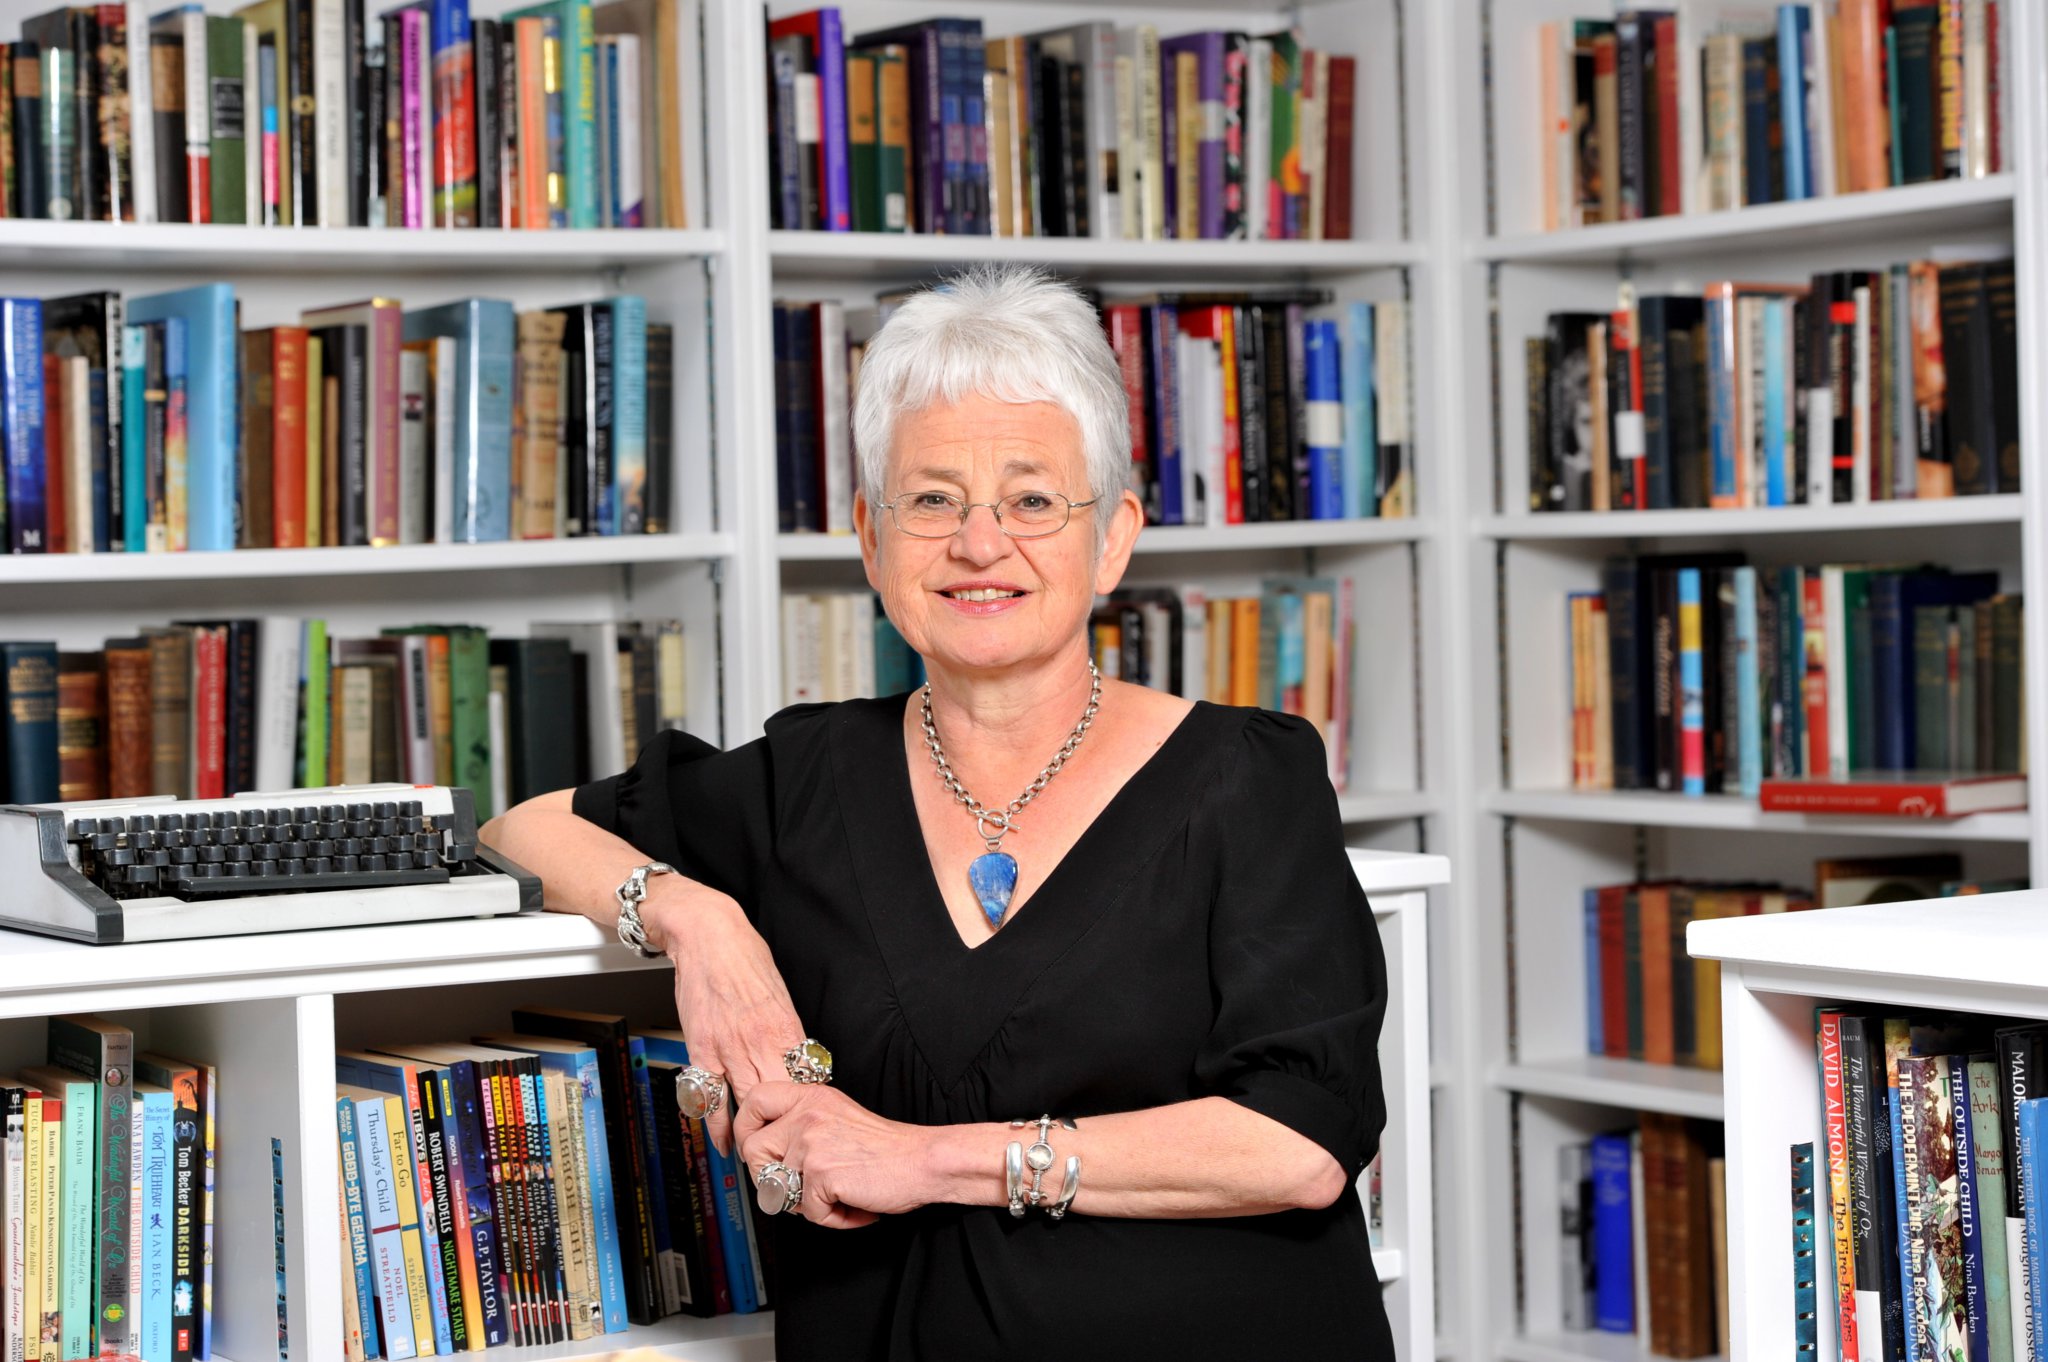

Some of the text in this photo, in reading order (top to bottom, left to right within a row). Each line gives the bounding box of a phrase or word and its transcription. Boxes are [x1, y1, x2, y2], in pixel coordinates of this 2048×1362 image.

[108, 1094, 128, 1120] The
[1972, 1092, 2000, 1117] Ark
[1974, 1072, 1990, 1089] The
[31, 1104, 39, 1133] TUCK
[48, 1130, 56, 1157] BARRIE
[76, 1106, 85, 1137] FRANK
[344, 1105, 352, 1136] ARMADA
[414, 1123, 427, 1160] BOYS
[528, 1079, 536, 1121] TELLING
[533, 1127, 541, 1157] TALES
[539, 1184, 547, 1206] ANNE
[589, 1110, 597, 1125] THE
[30, 1139, 38, 1215] EVERLASTING
[76, 1140, 84, 1165] BAUM
[104, 1125, 128, 1183] Wonderful
[146, 1126, 167, 1210] TOM TRUEHEART
[367, 1109, 391, 1213] Thursday's Child
[393, 1130, 410, 1188] Far to Go
[429, 1131, 444, 1172] ROBERT
[493, 1080, 518, 1242] TELLING TALES JENNY NIMMO
[504, 1081, 532, 1271] TELLING TALES MICHAEL MORPURGO
[514, 1082, 540, 1260] TELLING TALES THERESA BRESLIN
[521, 1078, 546, 1246] TELLING TALES GILLIAN CROSS
[538, 1079, 564, 1271] TELLING TALES MICHELLE MAGORIAN
[591, 1127, 602, 1176] ADVENTURES
[1844, 1083, 1852, 1124] KANSAS
[1848, 1130, 1856, 1201] CENTENNIAL
[1852, 1207, 1860, 1256] EDITION
[1850, 1057, 1872, 1239] The Wonderful Wizard of Oz
[48, 1165, 56, 1190] PETER
[48, 1191, 56, 1206] PAN
[130, 1112, 142, 1294] NINA BAWDEN THE OUTSIDE CHILD
[342, 1141, 368, 1266] GOOD-BYE GEMMA
[420, 1168, 432, 1198] Club
[433, 1176, 452, 1234] SWINDELLS
[449, 1135, 466, 1229] ROOM 13 Robert Swindells
[483, 1082, 512, 1274] TELLING TALES JACQUELINE WILSON
[558, 1123, 582, 1272] THE HOBBIT
[597, 1179, 603, 1188] OF
[697, 1156, 714, 1217] SKYMAZE
[1822, 1023, 1853, 1342] DAVID ALMOND The Fire-Eaters
[1952, 1068, 1979, 1333] THE OUTSIDE CHILD Nina Bawden
[48, 1207, 55, 1216] IN
[108, 1186, 126, 1231] Wizard
[177, 1146, 192, 1276] Tom Becker DARKSIDE
[601, 1211, 609, 1242] SAWYER
[1891, 1092, 1920, 1362] SECRET HEART DAVID ALMOND
[1898, 1070, 1929, 1344] THE PEPPERMINT PIG Nina Bawden
[29, 1251, 37, 1276] Babbitt
[47, 1217, 55, 1266] KENSINGTON
[103, 1233, 122, 1245] of
[105, 1247, 125, 1269] Oz
[152, 1233, 162, 1259] IAN
[2022, 1137, 2044, 1346] THE SKETCH BOOK OF MARGARET BAKER
[11, 1217, 25, 1326] Grandmother's Footsteps
[151, 1263, 161, 1301] BECK
[380, 1247, 404, 1323] NOEL STREATFEILD
[407, 1257, 421, 1320] STREATFEILD
[417, 1274, 426, 1300] NOEL
[430, 1243, 449, 1318] Amanda Swift
[442, 1239, 461, 1306] NIGHTMARE
[476, 1230, 498, 1320] G.P. TAYLOR
[608, 1276, 616, 1302] TWAIN
[355, 1268, 370, 1340] NOEL STREATFEILD
[451, 1307, 466, 1341] STAIRS
[2025, 1304, 2037, 1362] Crosses
[28, 1336, 36, 1355] FSG
